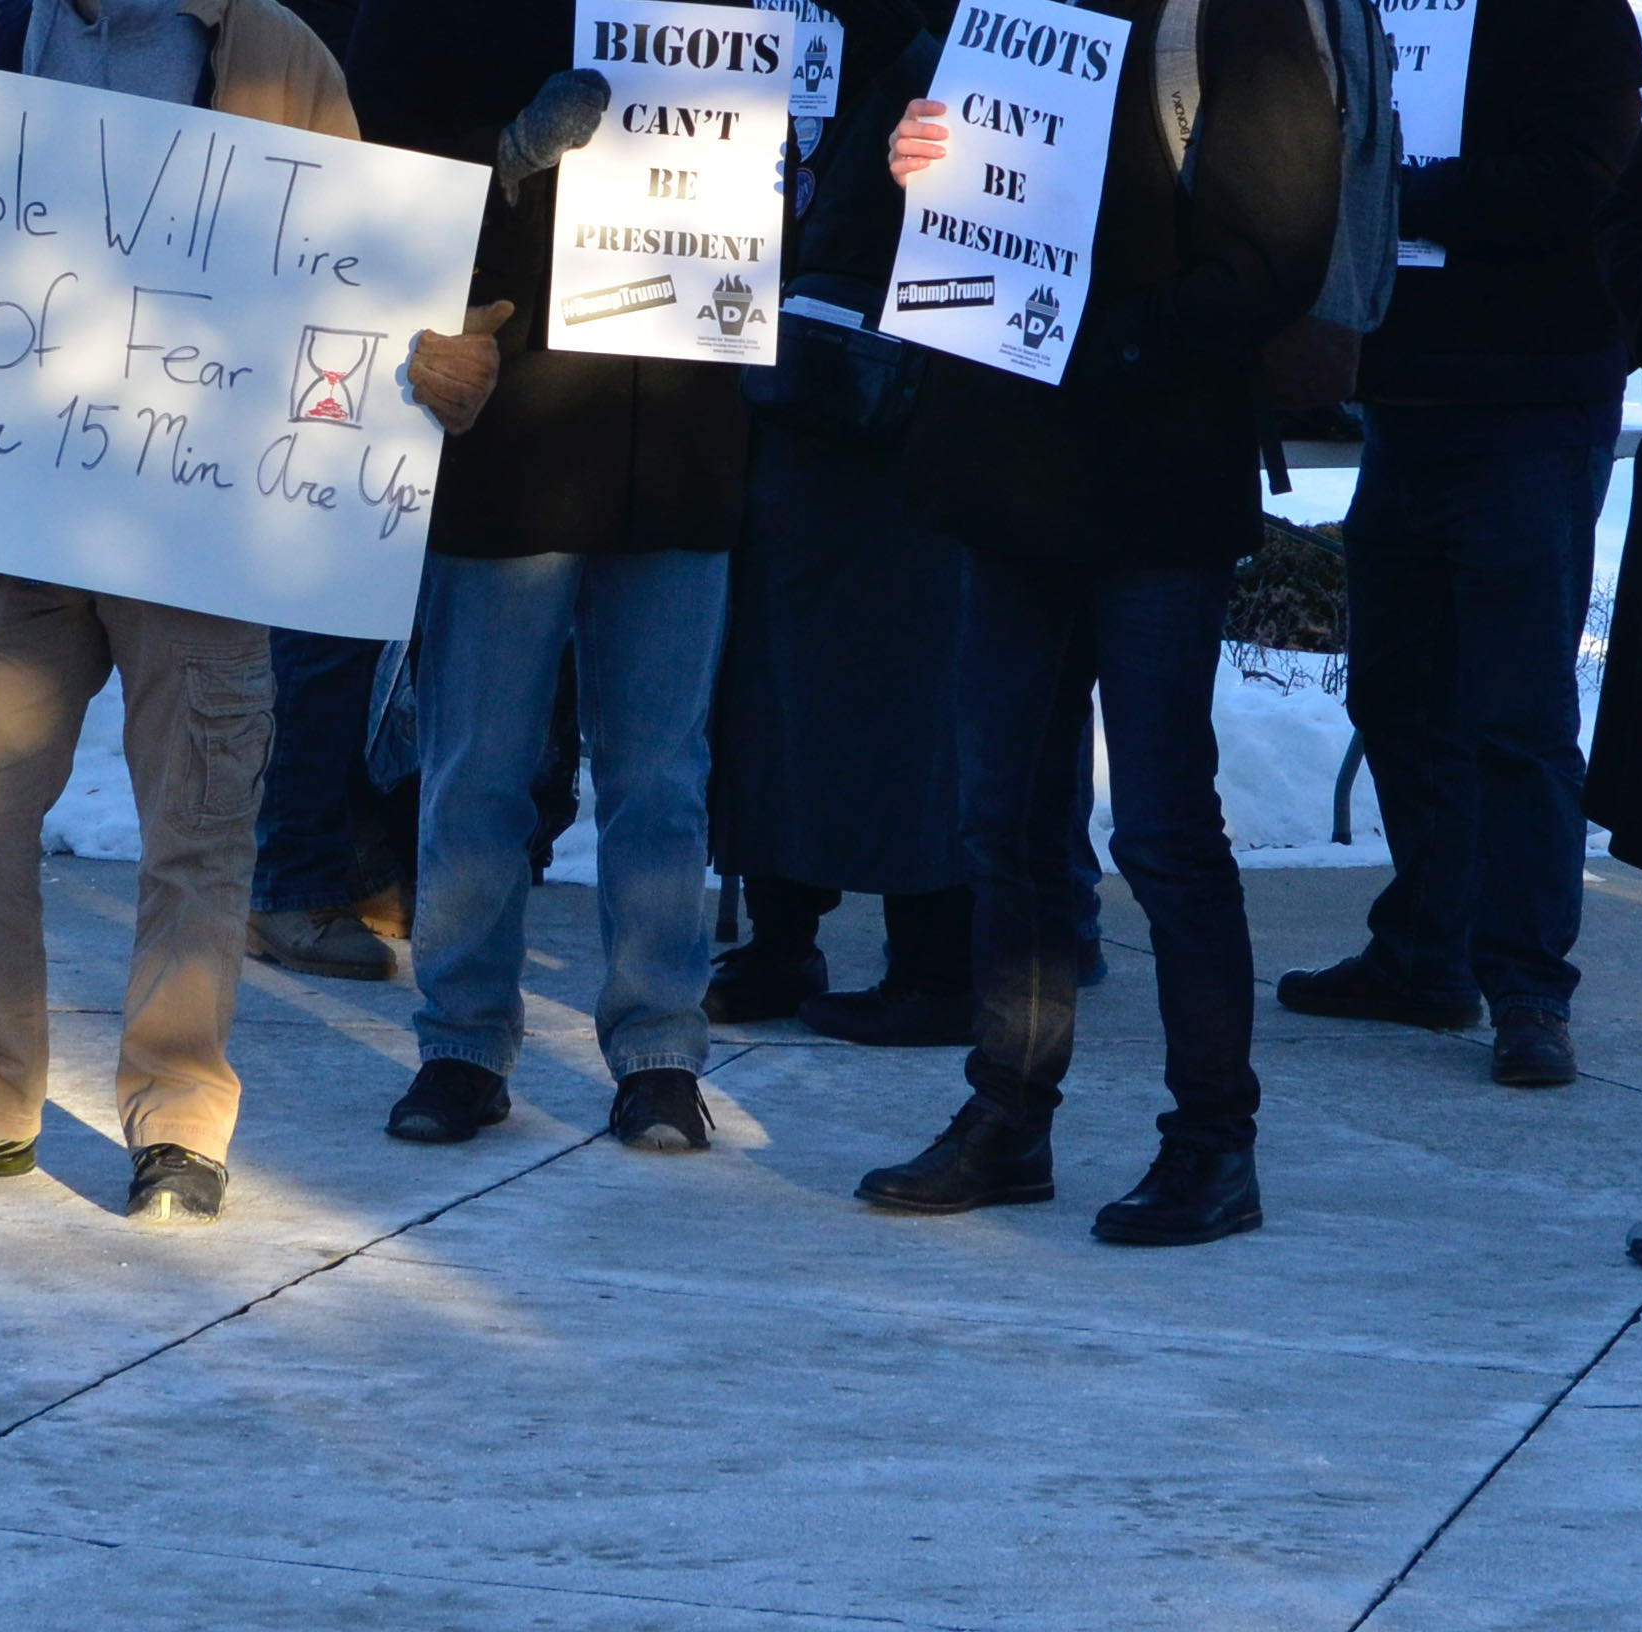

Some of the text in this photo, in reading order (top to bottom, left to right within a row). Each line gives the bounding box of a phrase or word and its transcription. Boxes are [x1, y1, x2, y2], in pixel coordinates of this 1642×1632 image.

[593, 21, 780, 74] BIGOTS
[958, 7, 1111, 82] BIGOTS
[793, 64, 834, 80] ADA
[622, 103, 740, 141] CAN'T
[961, 92, 1064, 146] CAN'T
[100, 117, 235, 272] Will
[264, 155, 361, 287] Tire
[648, 167, 698, 201] BE
[984, 163, 1026, 202] BE
[575, 224, 765, 262] PRESIDENT
[919, 208, 1078, 278] PRESIDENT
[124, 285, 253, 390] Fear
[696, 304, 767, 324] ADA
[898, 280, 1064, 342] #DumpTrump ADA
[55, 395, 119, 470] 15
[135, 408, 233, 489] Min
[257, 432, 337, 510] Are
